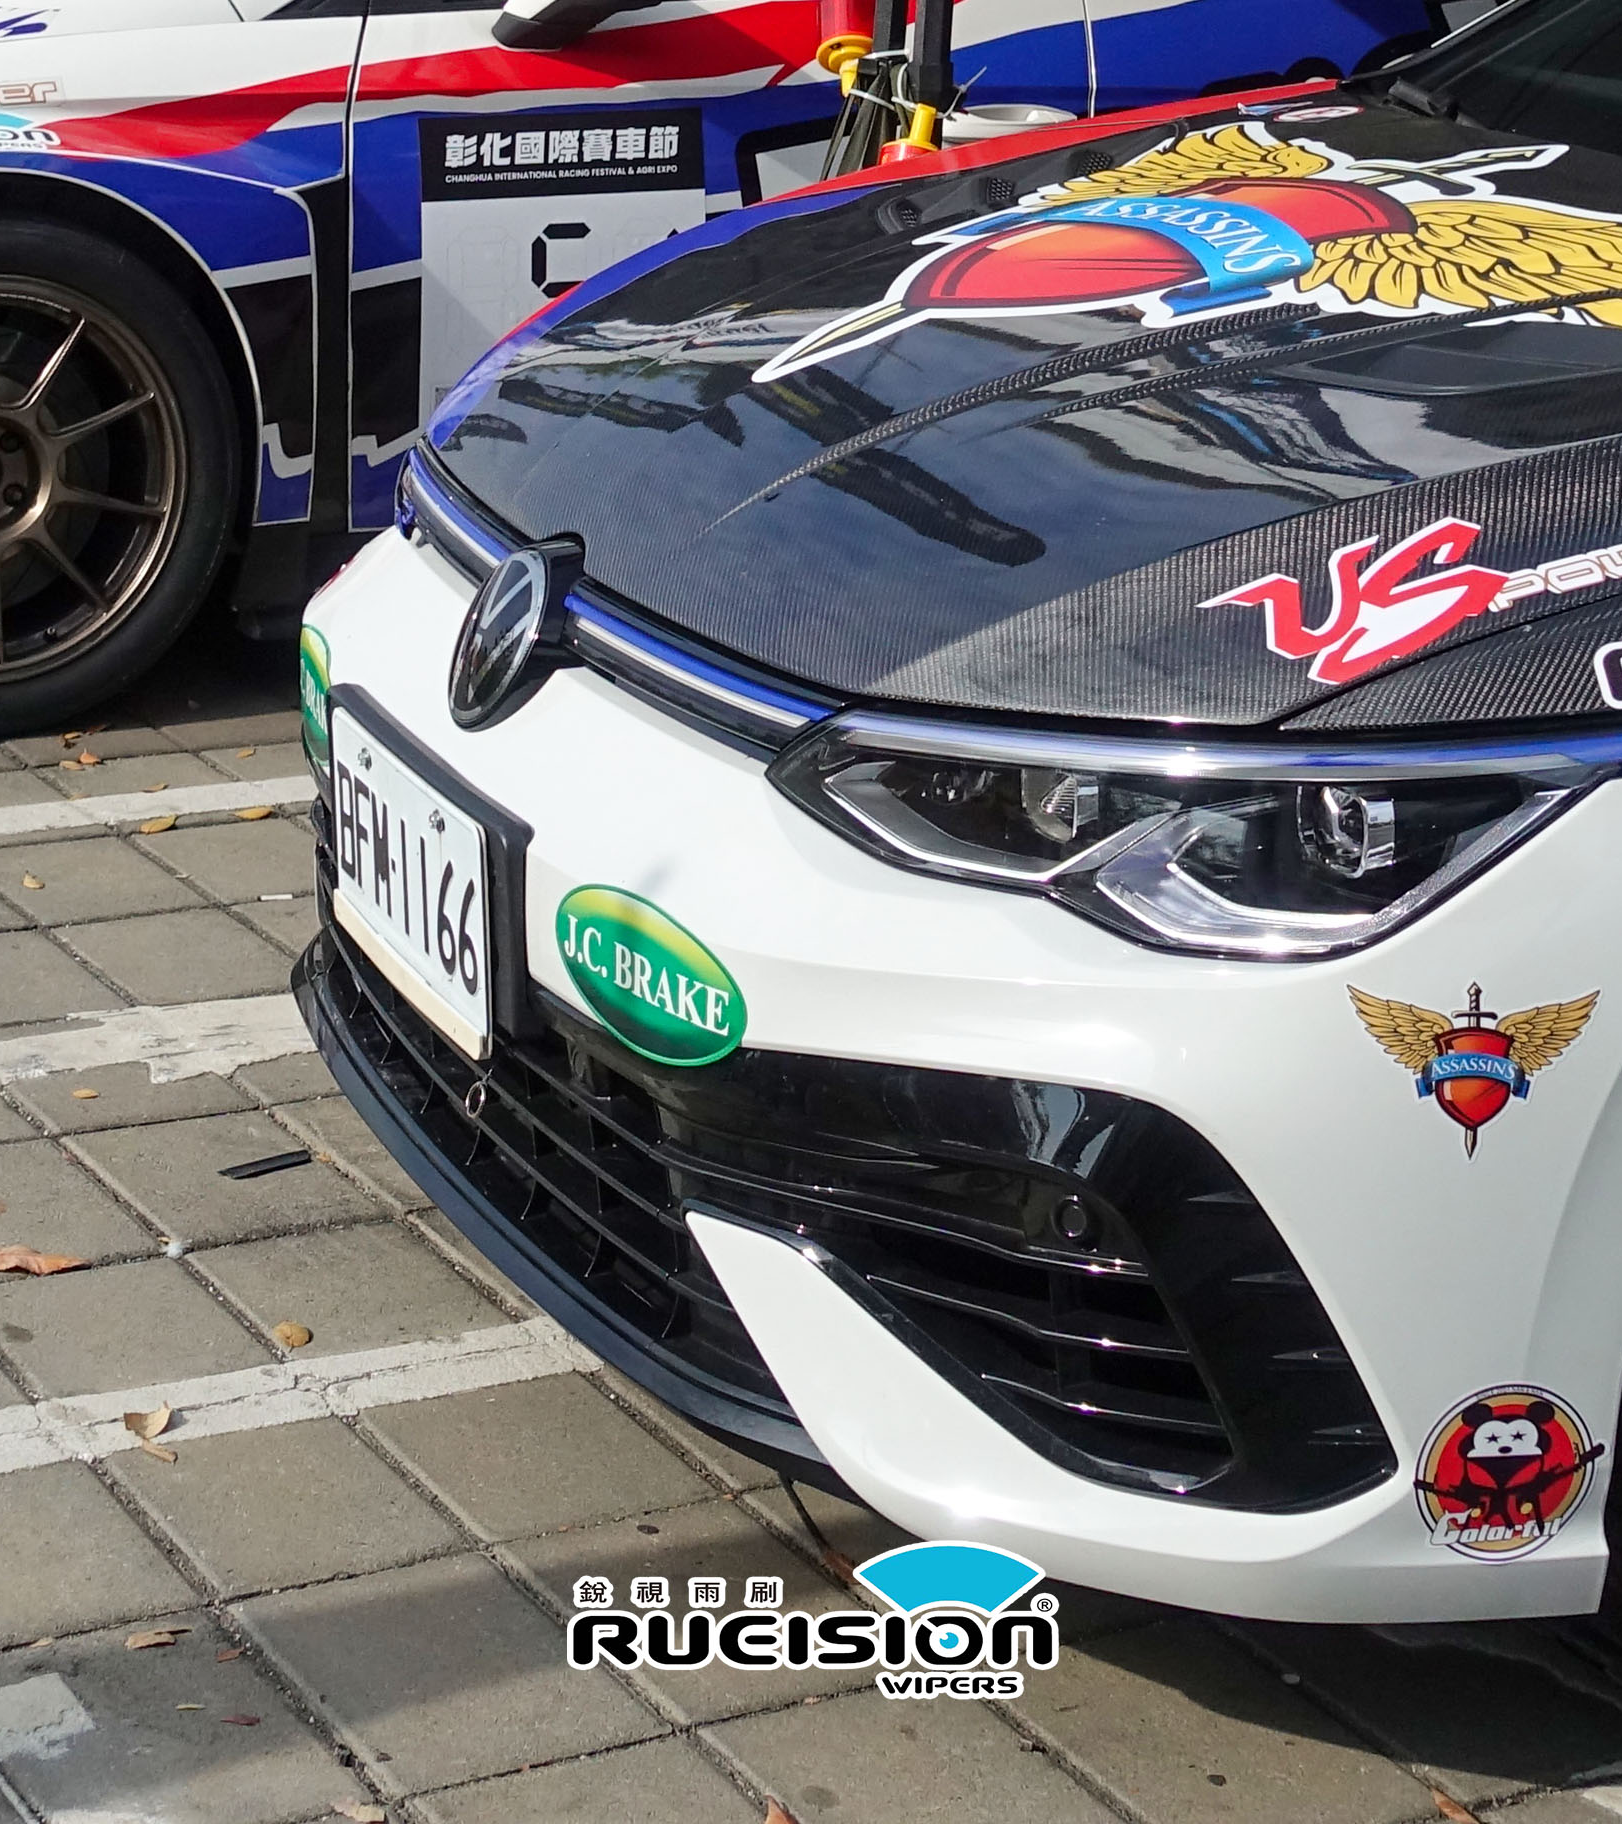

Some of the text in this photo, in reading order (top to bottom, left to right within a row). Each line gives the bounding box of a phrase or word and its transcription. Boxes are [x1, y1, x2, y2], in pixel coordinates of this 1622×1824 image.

[445, 126, 679, 169] 彰化國際賽車節
[445, 164, 677, 184] CHANGHUA INTERNATIONAL RACING FESTIVAL & AGRI EXPO
[1084, 196, 1304, 277] ASSASSINS
[305, 679, 329, 737] BRAK
[336, 760, 479, 996] BFM-1166
[563, 914, 731, 1038] J.C. BRAKE
[1429, 1056, 1520, 1083] ASSASSINS
[1431, 1508, 1565, 1546] Colorful
